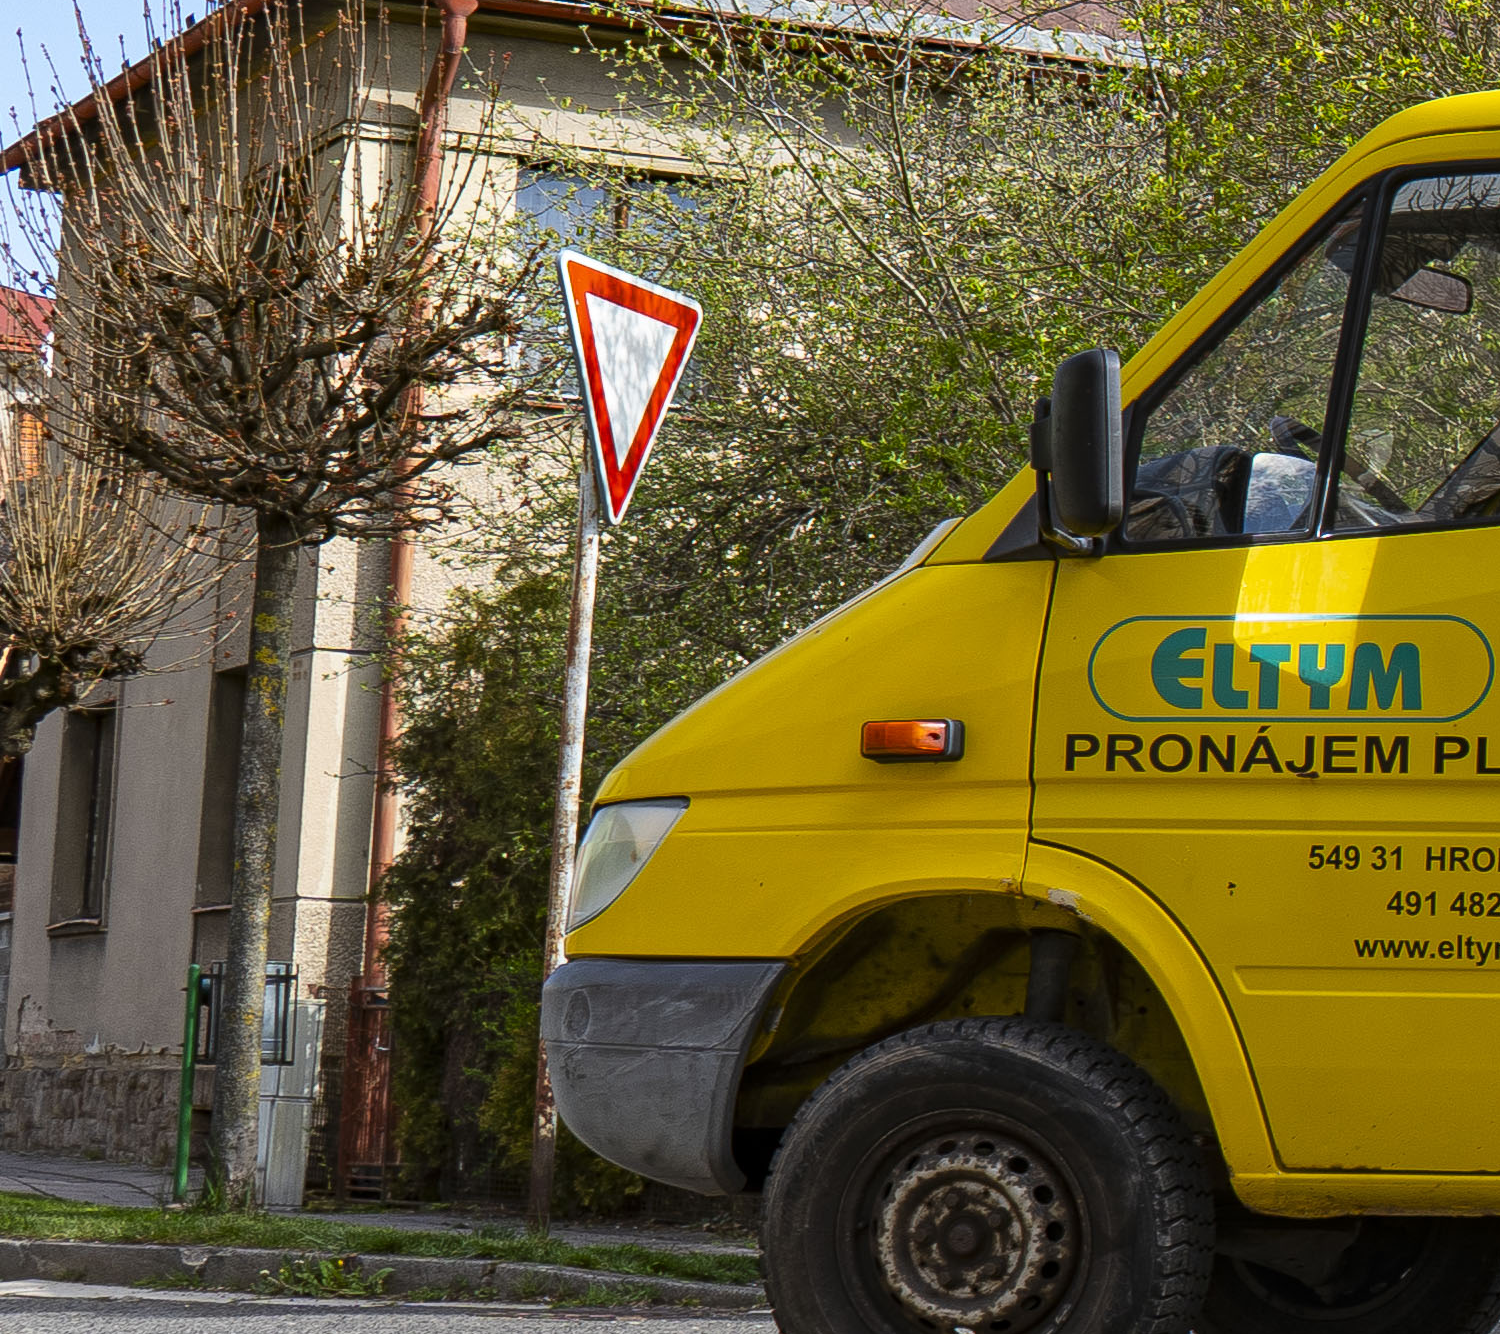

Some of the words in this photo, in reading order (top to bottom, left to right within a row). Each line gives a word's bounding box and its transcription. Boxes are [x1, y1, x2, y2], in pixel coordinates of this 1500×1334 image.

[1151, 627, 1423, 711] ELTYM
[1065, 725, 1410, 775] PRONÁJEM
[1308, 844, 1361, 871] 549
[1371, 845, 1402, 871] 31
[1386, 890, 1437, 916] 491
